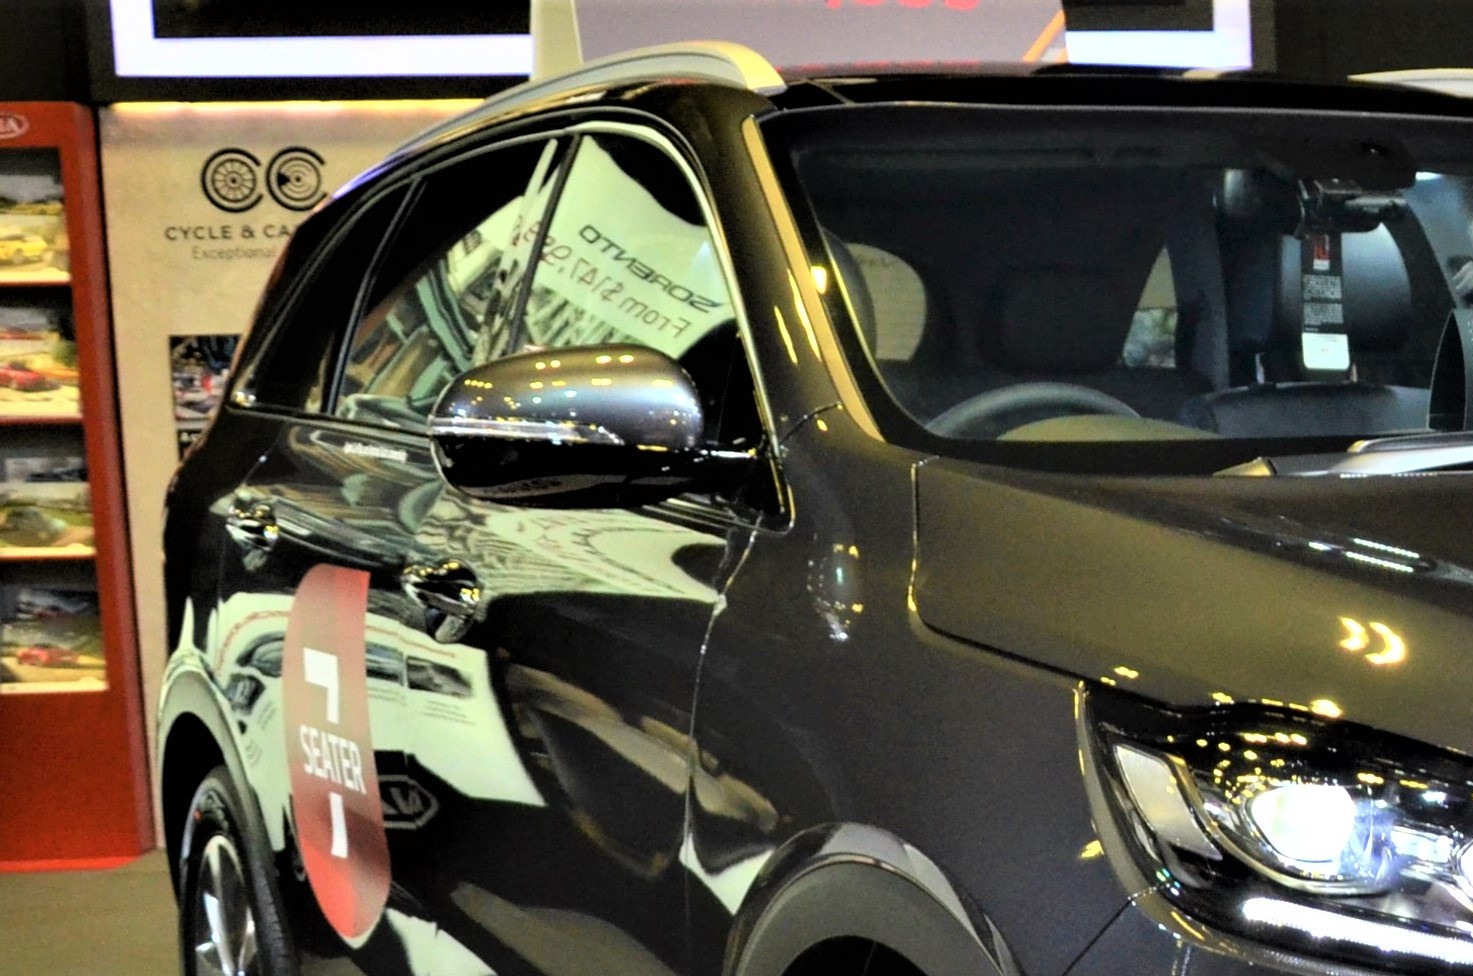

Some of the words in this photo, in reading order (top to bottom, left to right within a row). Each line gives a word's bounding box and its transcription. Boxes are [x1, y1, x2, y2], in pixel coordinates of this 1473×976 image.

[164, 225, 232, 241] CYCLE
[240, 224, 255, 240] &
[263, 224, 298, 240] CA
[299, 724, 367, 795] SEATER
